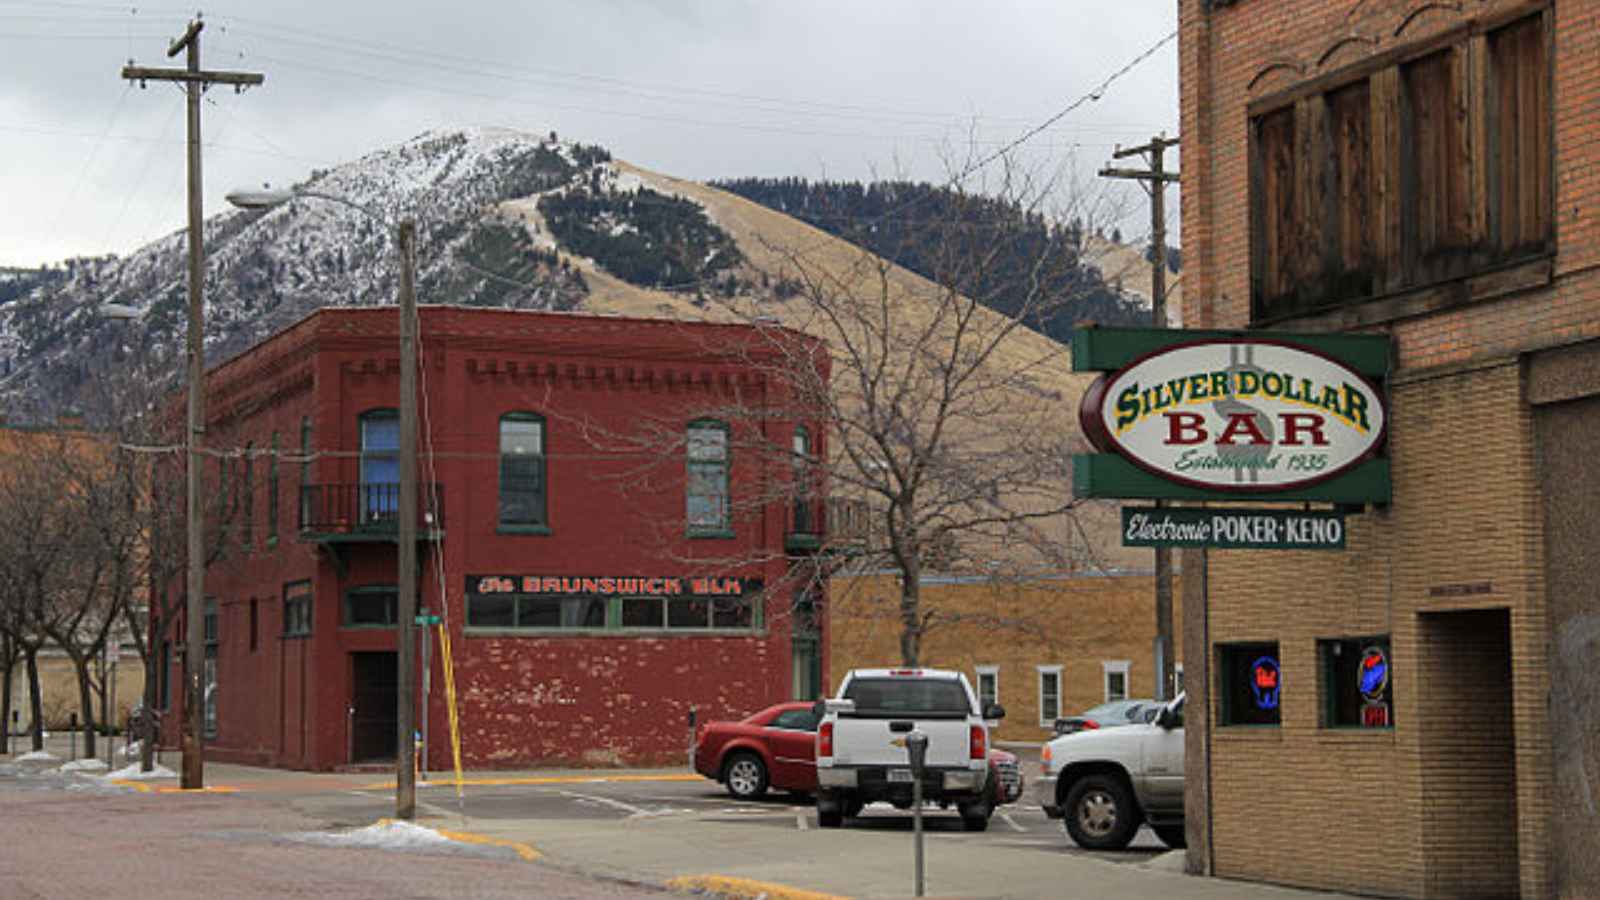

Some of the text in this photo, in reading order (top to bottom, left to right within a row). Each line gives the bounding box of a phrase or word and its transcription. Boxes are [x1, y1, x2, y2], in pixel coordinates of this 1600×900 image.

[1114, 371, 1371, 434] SILVER DOLLAR
[1163, 412, 1330, 445] BAR
[1287, 453, 1328, 471] 1935
[1125, 514, 1211, 541] Electronic
[523, 577, 681, 594] BRUNSWICK
